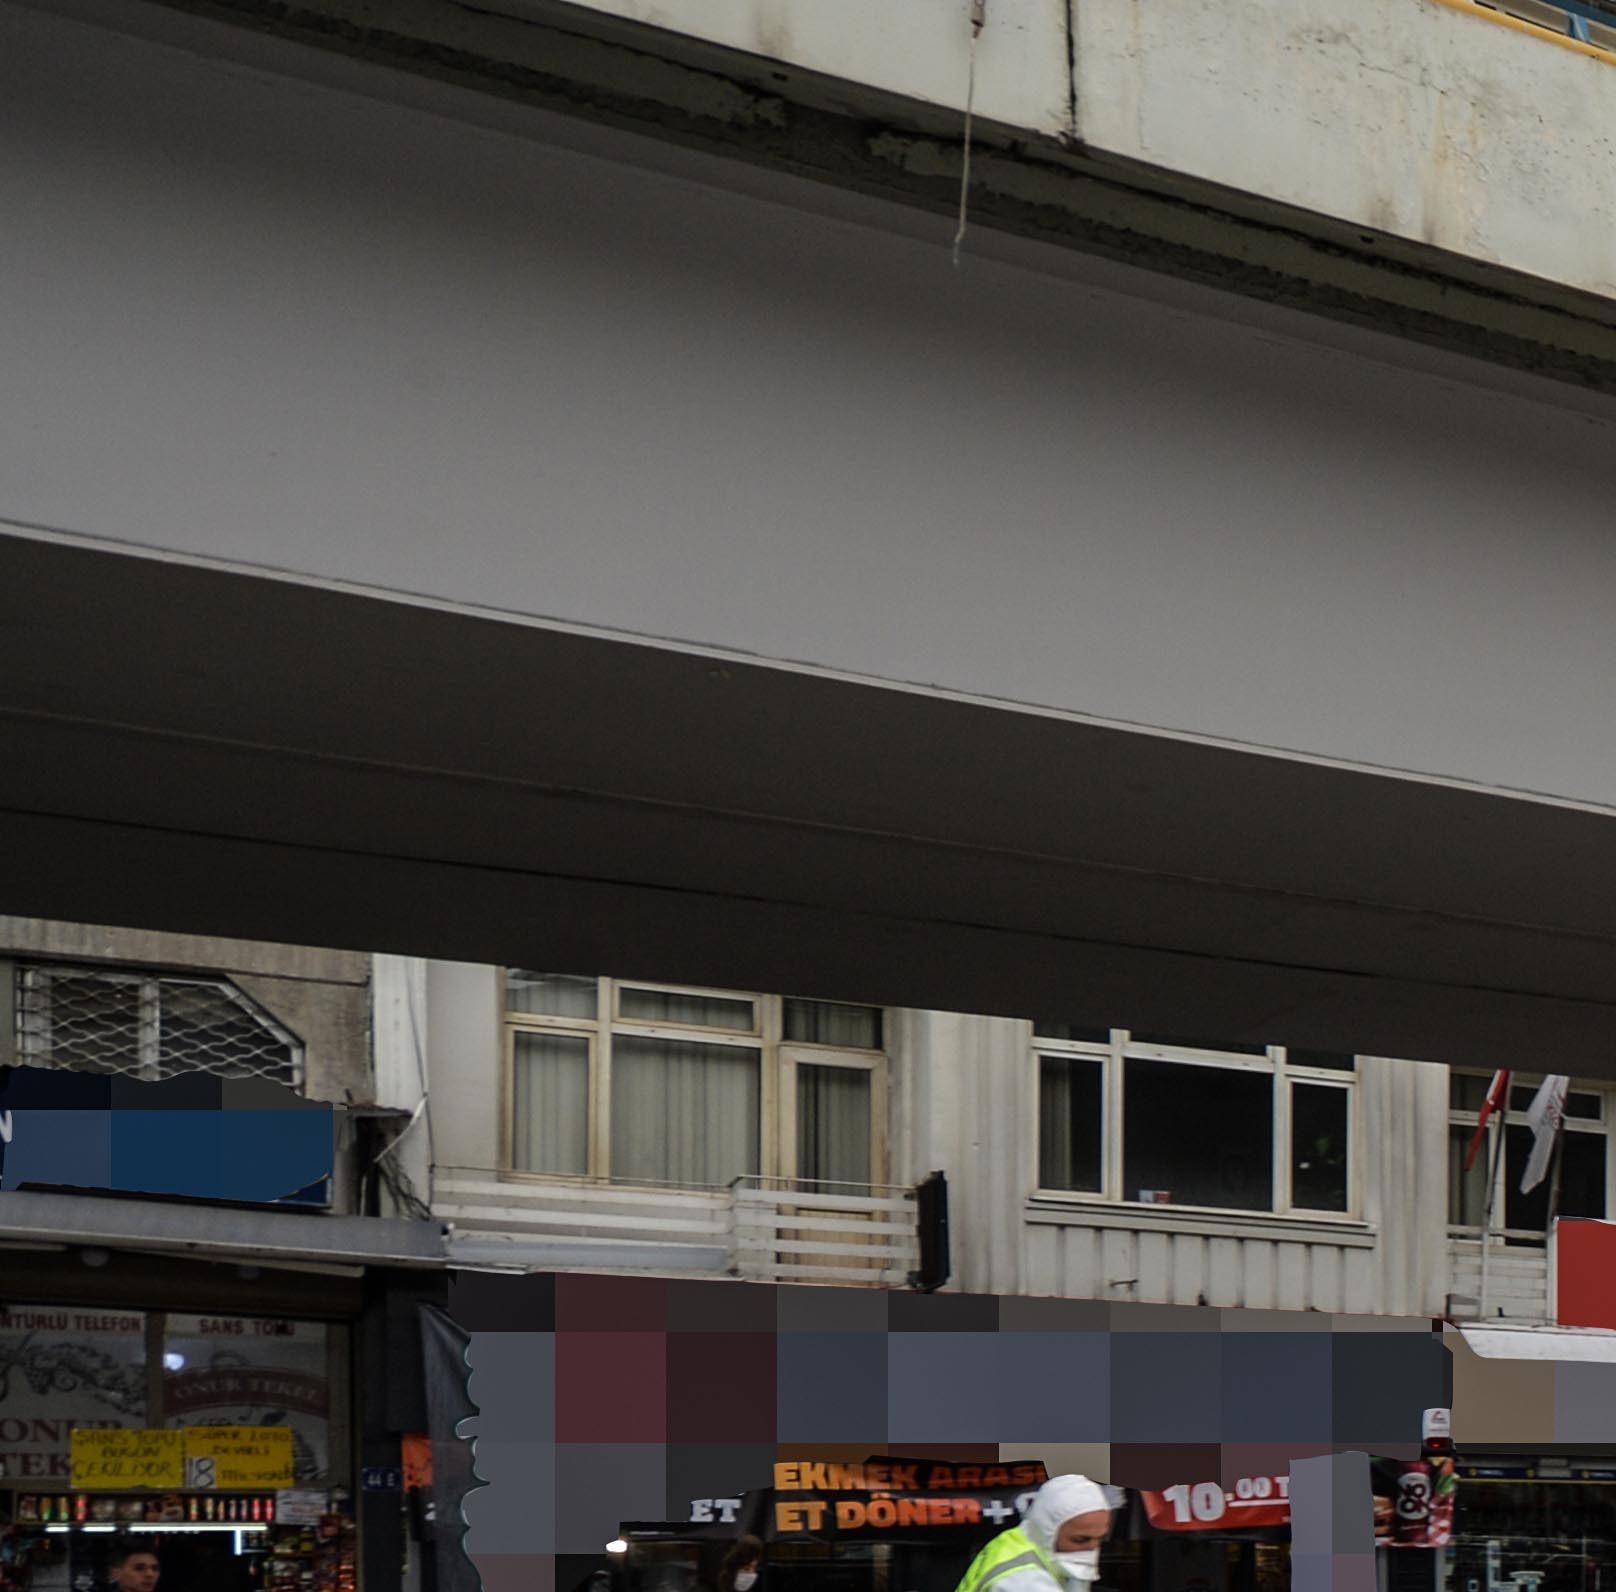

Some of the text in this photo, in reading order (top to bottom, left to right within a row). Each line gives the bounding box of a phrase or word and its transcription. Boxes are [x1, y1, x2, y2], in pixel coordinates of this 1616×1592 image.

[74, 1313, 142, 1331] TELEFON
[773, 1461, 920, 1491] EKMEK
[689, 1498, 741, 1523] ET
[776, 1501, 828, 1532] ET
